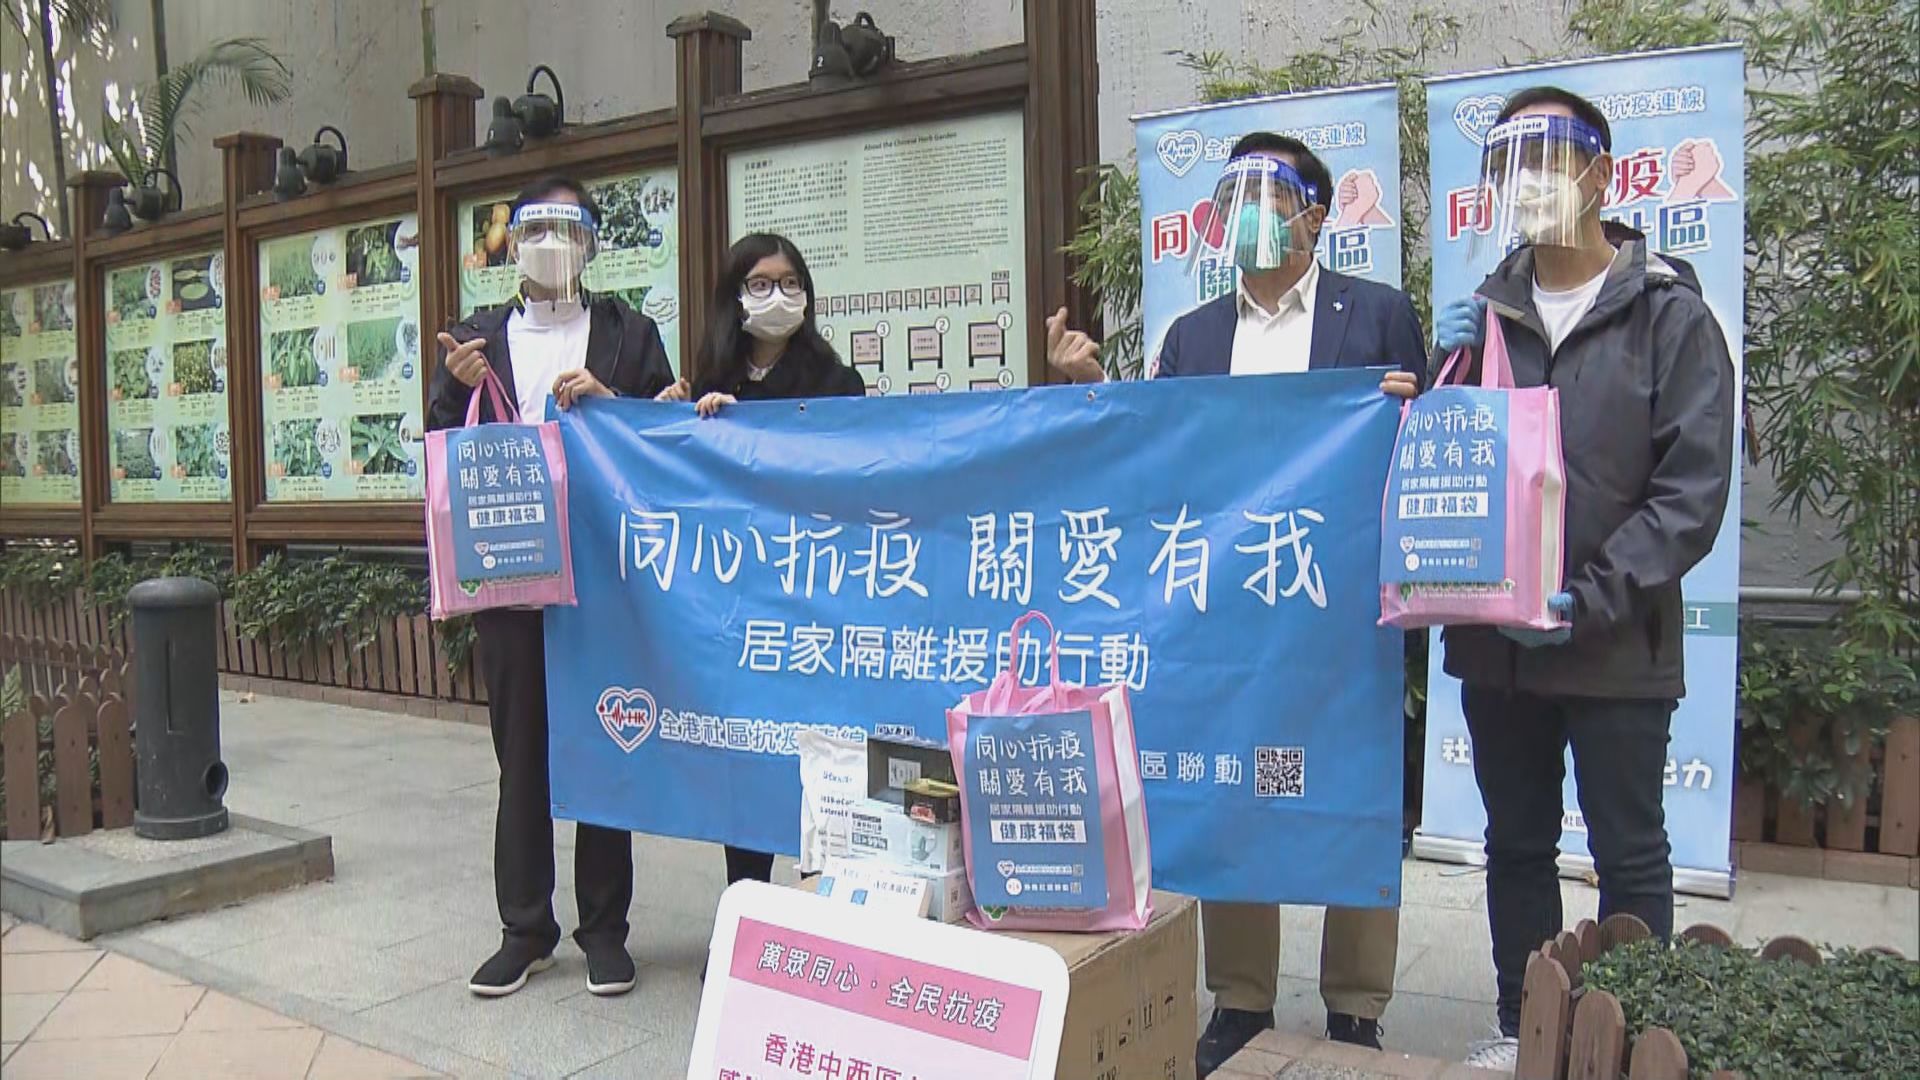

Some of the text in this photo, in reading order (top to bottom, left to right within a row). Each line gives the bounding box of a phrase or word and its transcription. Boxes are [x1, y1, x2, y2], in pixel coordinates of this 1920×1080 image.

[1153, 214, 1188, 261] 同
[938, 319, 946, 330] 2
[1405, 403, 1498, 437] 同心抗疫
[458, 436, 540, 462] 同心抗疫
[1399, 438, 1496, 472] 關愛有我
[460, 462, 544, 489] 關愛有我
[476, 507, 537, 525] 健康福袋
[1406, 495, 1478, 515] 健康福袋
[618, 503, 1327, 613] 同心抗疫 關愛有我
[627, 710, 646, 725] HK
[976, 730, 1086, 763] 同心抗疫
[978, 766, 1088, 797] 關愛有我
[999, 821, 1077, 841] 健康福袋
